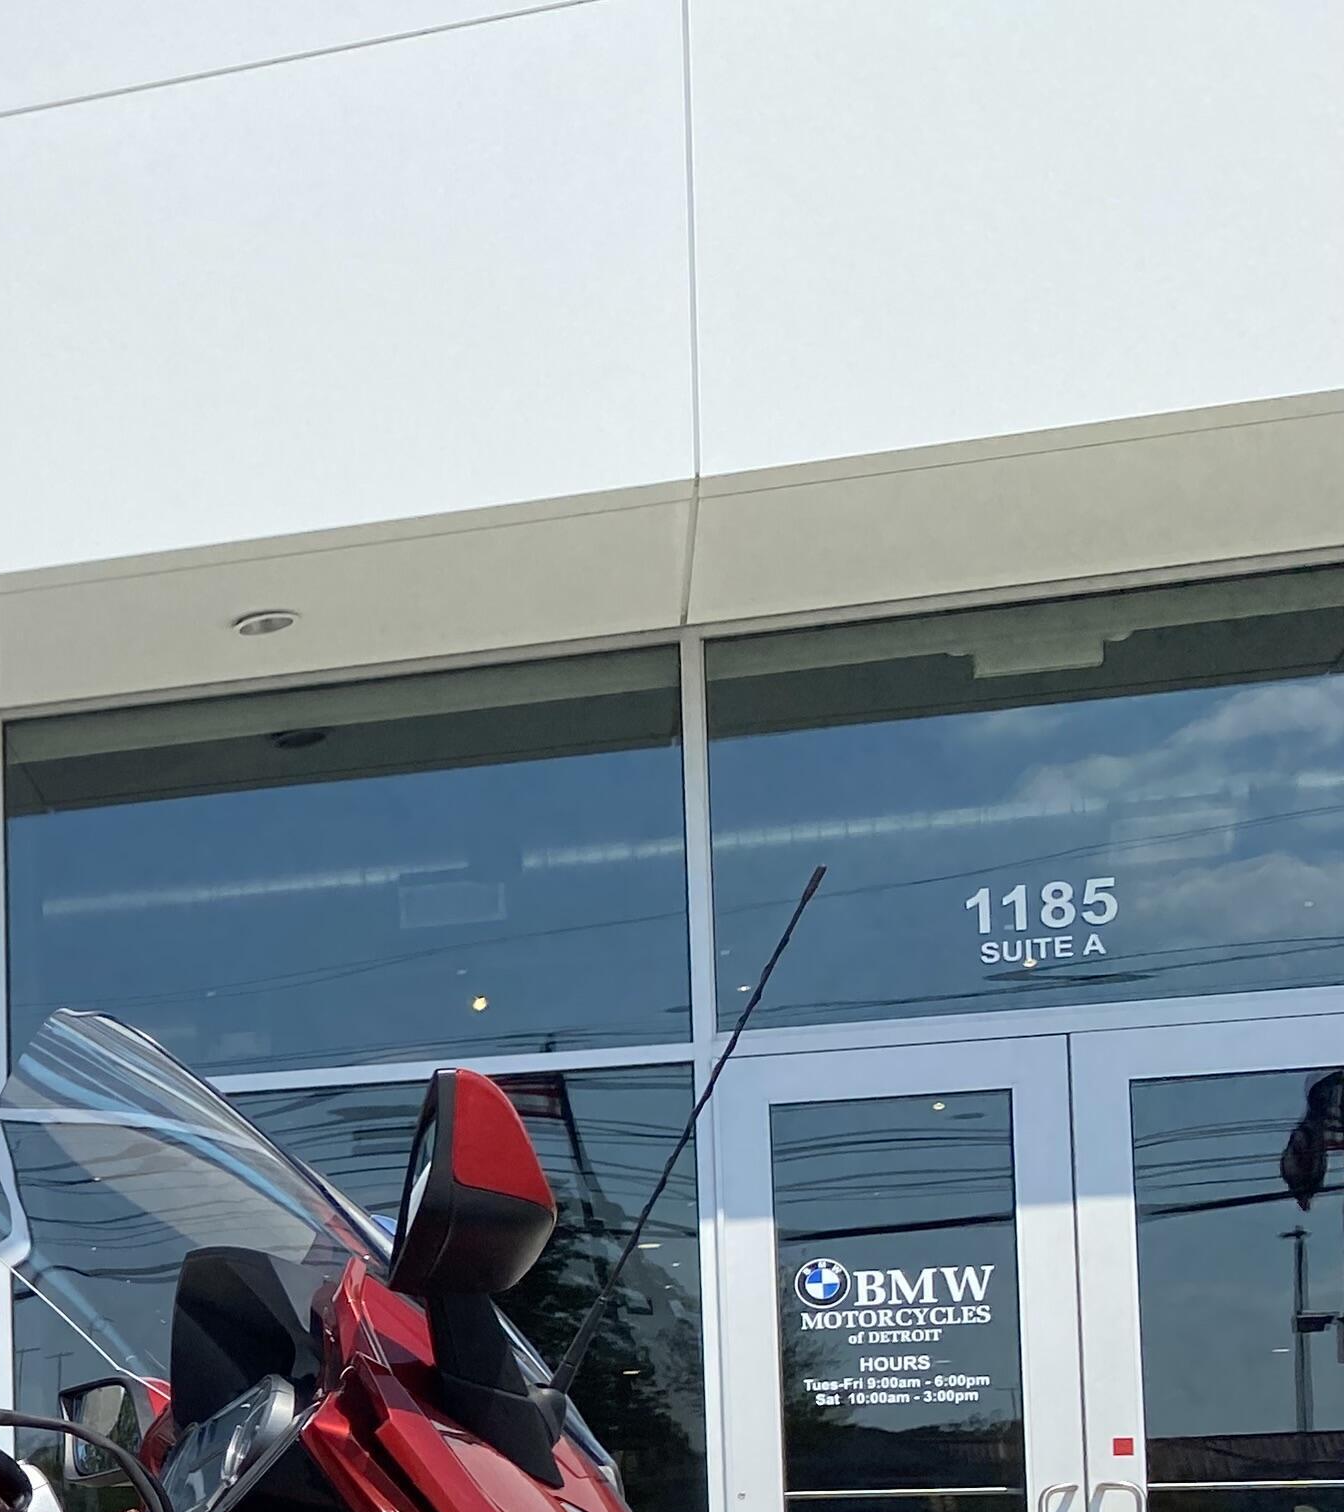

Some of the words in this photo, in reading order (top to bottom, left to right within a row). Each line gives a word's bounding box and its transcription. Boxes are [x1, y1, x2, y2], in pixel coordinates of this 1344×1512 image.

[965, 877, 1119, 935] 1185
[980, 935, 1074, 964] SUITE
[1082, 933, 1107, 956] A
[853, 1264, 996, 1307] BMW
[800, 1304, 992, 1331] MOTORCYCLES
[848, 1331, 865, 1345] of
[868, 1328, 943, 1344] DETROIT
[859, 1354, 931, 1373] HOURS
[803, 1377, 863, 1392] Tues-Fri
[866, 1375, 921, 1390] 9:00am
[934, 1373, 991, 1390] 6:00pm
[815, 1393, 841, 1406] Sat
[849, 1391, 911, 1405] 10:00am
[923, 1389, 980, 1404] 3:00pm
